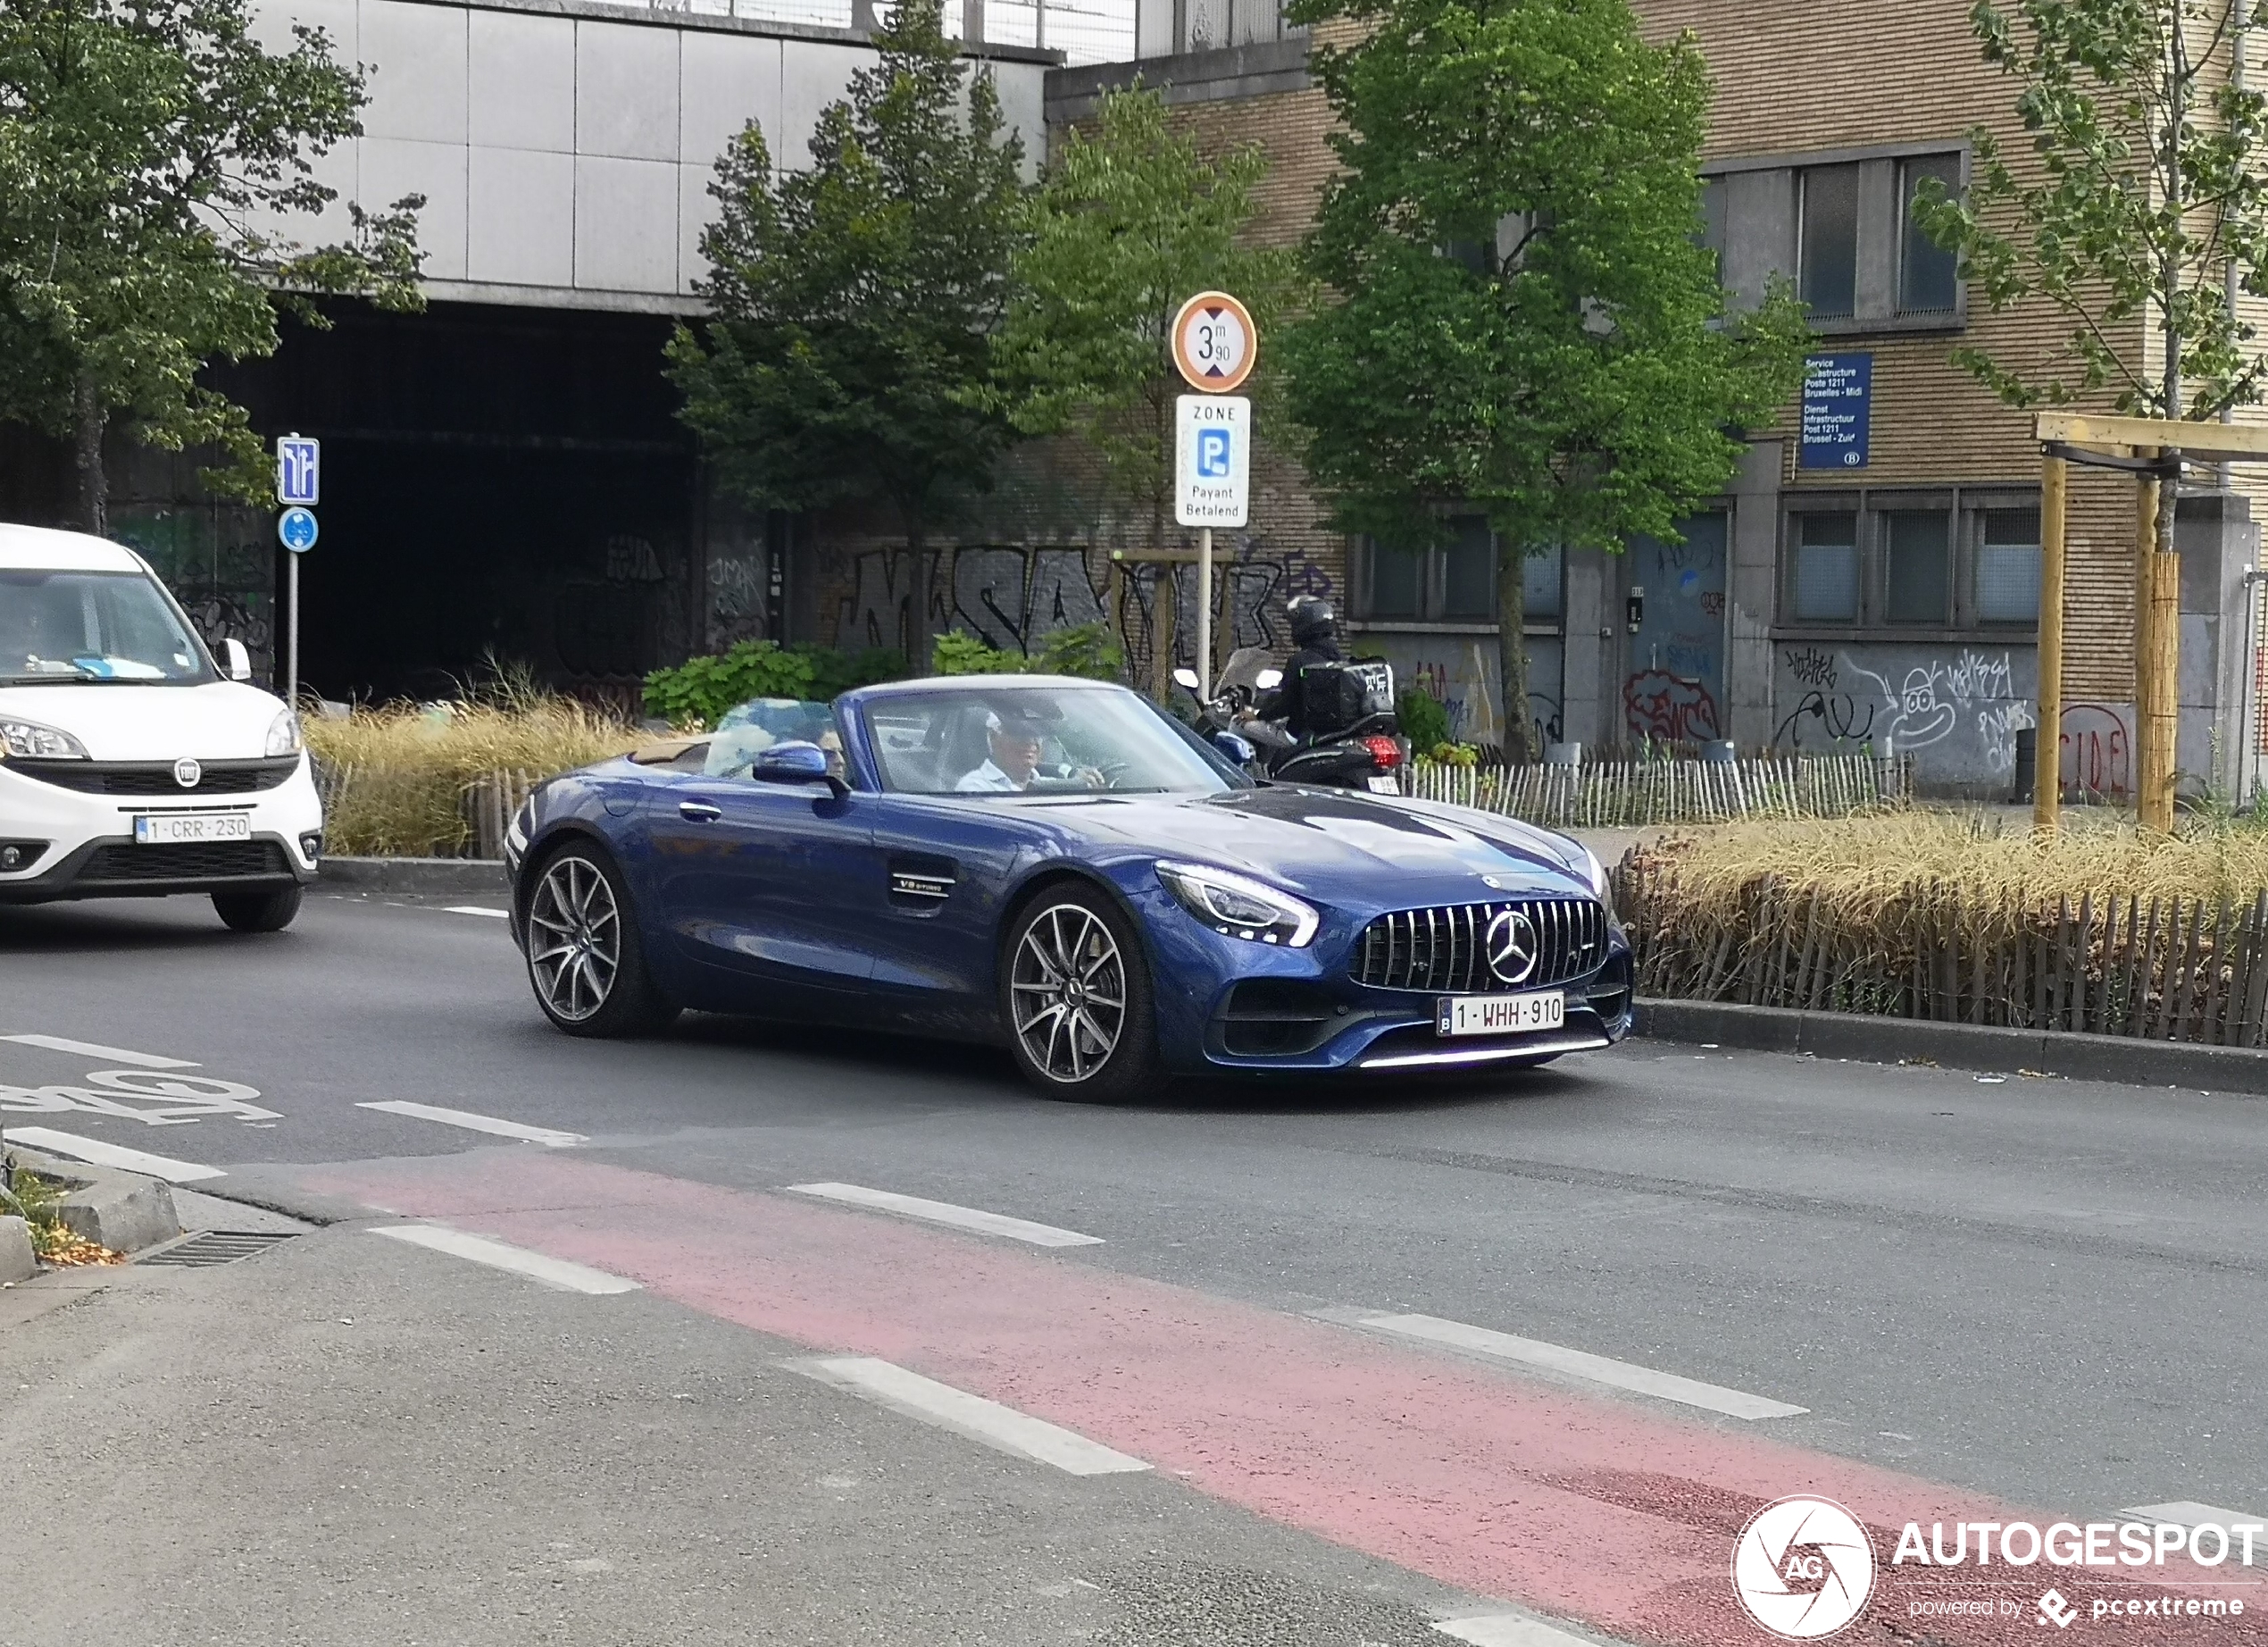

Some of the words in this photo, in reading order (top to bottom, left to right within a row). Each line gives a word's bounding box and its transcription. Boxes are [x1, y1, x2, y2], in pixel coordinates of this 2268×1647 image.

[1215, 324, 1226, 338] m
[1198, 325, 1213, 359] 3
[1216, 346, 1230, 361] 90
[1805, 359, 1834, 368] Service
[1805, 379, 1827, 388] Poste
[1828, 378, 1846, 387] 1211
[1805, 389, 1839, 398] Bruxelles
[1846, 387, 1863, 397] Midi
[1193, 405, 1236, 421] ZONE
[1804, 405, 1829, 414] Dienst
[1804, 414, 1855, 423] Infrastructuur
[1804, 424, 1821, 433] Post
[1822, 424, 1839, 433] 1211
[1803, 434, 1832, 444] Brussel
[1205, 437, 1223, 470] P
[1192, 485, 1233, 501] Payant
[1186, 503, 1239, 517] Betalend
[1441, 1018, 1450, 1030] B
